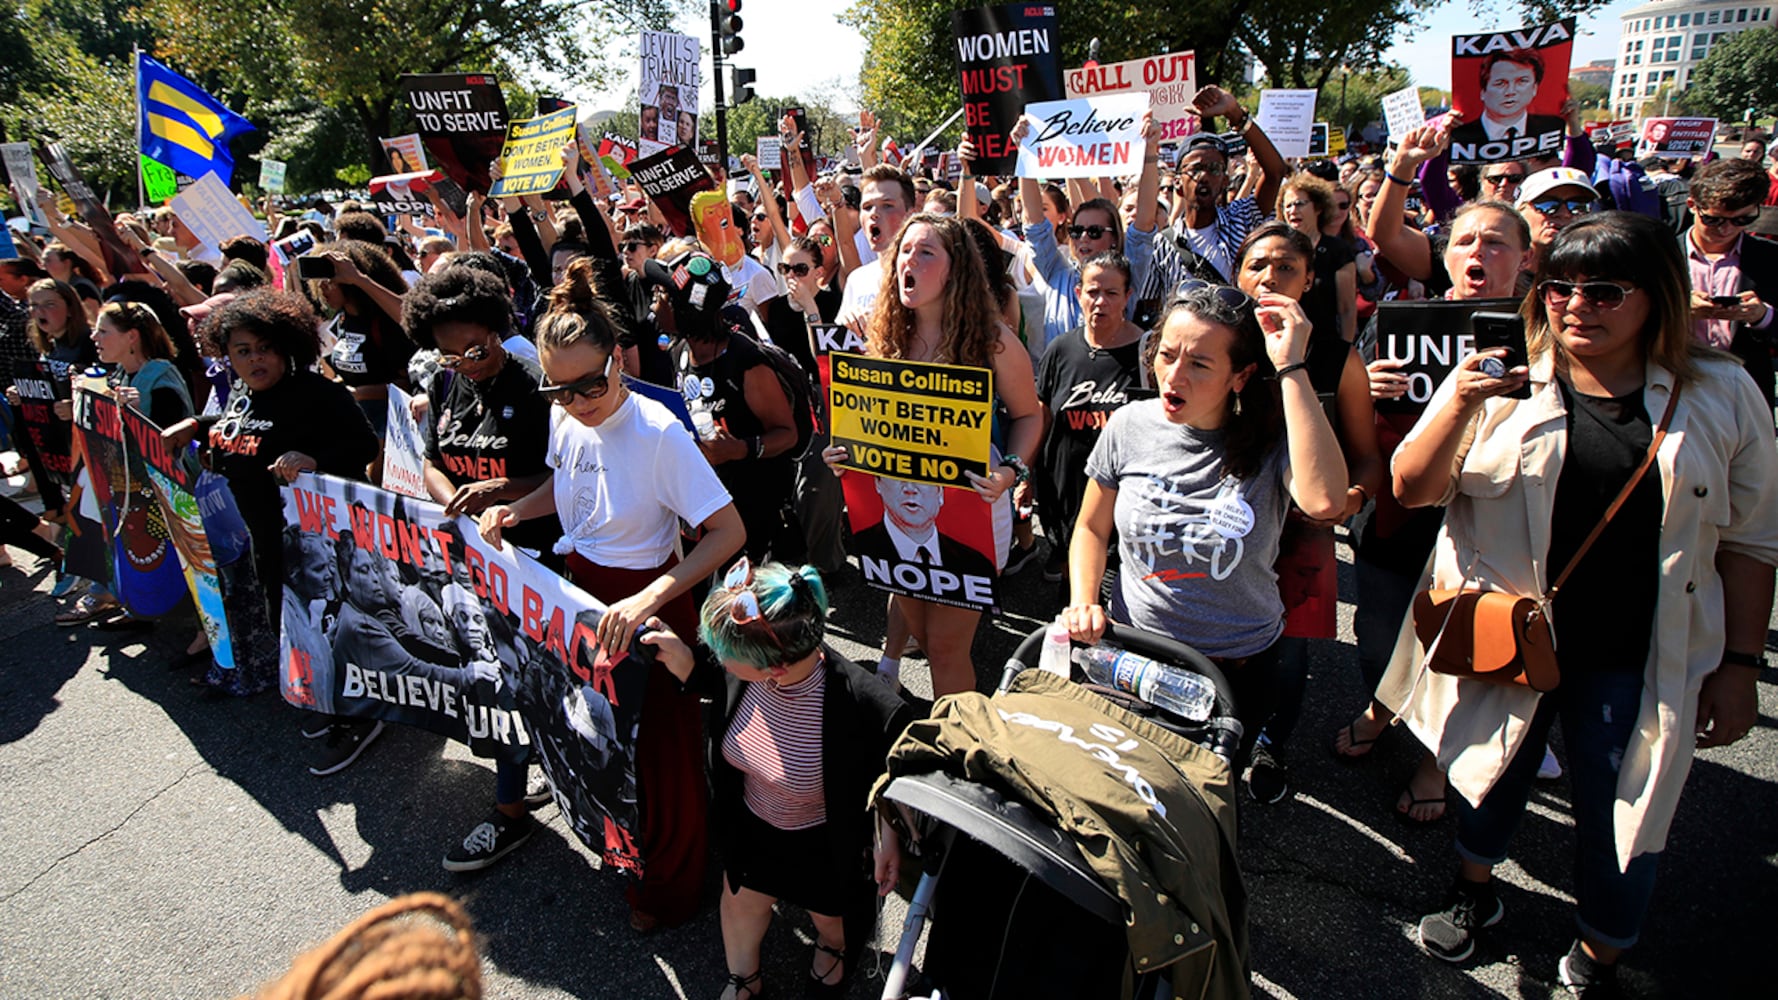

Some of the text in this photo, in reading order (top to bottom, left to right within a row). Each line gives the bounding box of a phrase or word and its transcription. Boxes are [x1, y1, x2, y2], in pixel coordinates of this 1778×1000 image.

[957, 28, 1050, 62] WOMEN
[1455, 22, 1570, 55] KAVA
[641, 56, 699, 88] TRIANGLE
[961, 63, 1028, 95] MUST
[1070, 54, 1195, 94] CALL OUT
[409, 90, 473, 111] UNFIT
[965, 102, 991, 127] BE
[416, 111, 508, 132] TO SERVE.
[511, 124, 541, 138] Susan
[1030, 108, 1135, 147] Believe
[503, 134, 573, 158] DON'T BETRAY
[605, 131, 637, 150] KAVA
[968, 133, 1019, 159] HEA
[1451, 131, 1561, 161] NOPE
[513, 154, 553, 170] WOMEN.
[634, 158, 675, 185] UNFIT
[502, 173, 553, 193] VOTE NO
[644, 164, 704, 197] TO SERVE.
[376, 201, 435, 217] NOPE
[815, 327, 866, 351] KA
[13, 377, 55, 400] WOMEN
[836, 361, 983, 396] Susan Collins:
[21, 403, 49, 424] MUST
[833, 390, 987, 429] DON'T BETRAY
[27, 426, 45, 447] BE
[860, 417, 949, 447] WOMEN.
[851, 444, 959, 481] VOTE NO
[861, 554, 994, 605] NOPE
[293, 487, 630, 707] WE WON'T GO BACK
[342, 662, 459, 718] BELIEVE
[1088, 722, 1139, 752] IS
